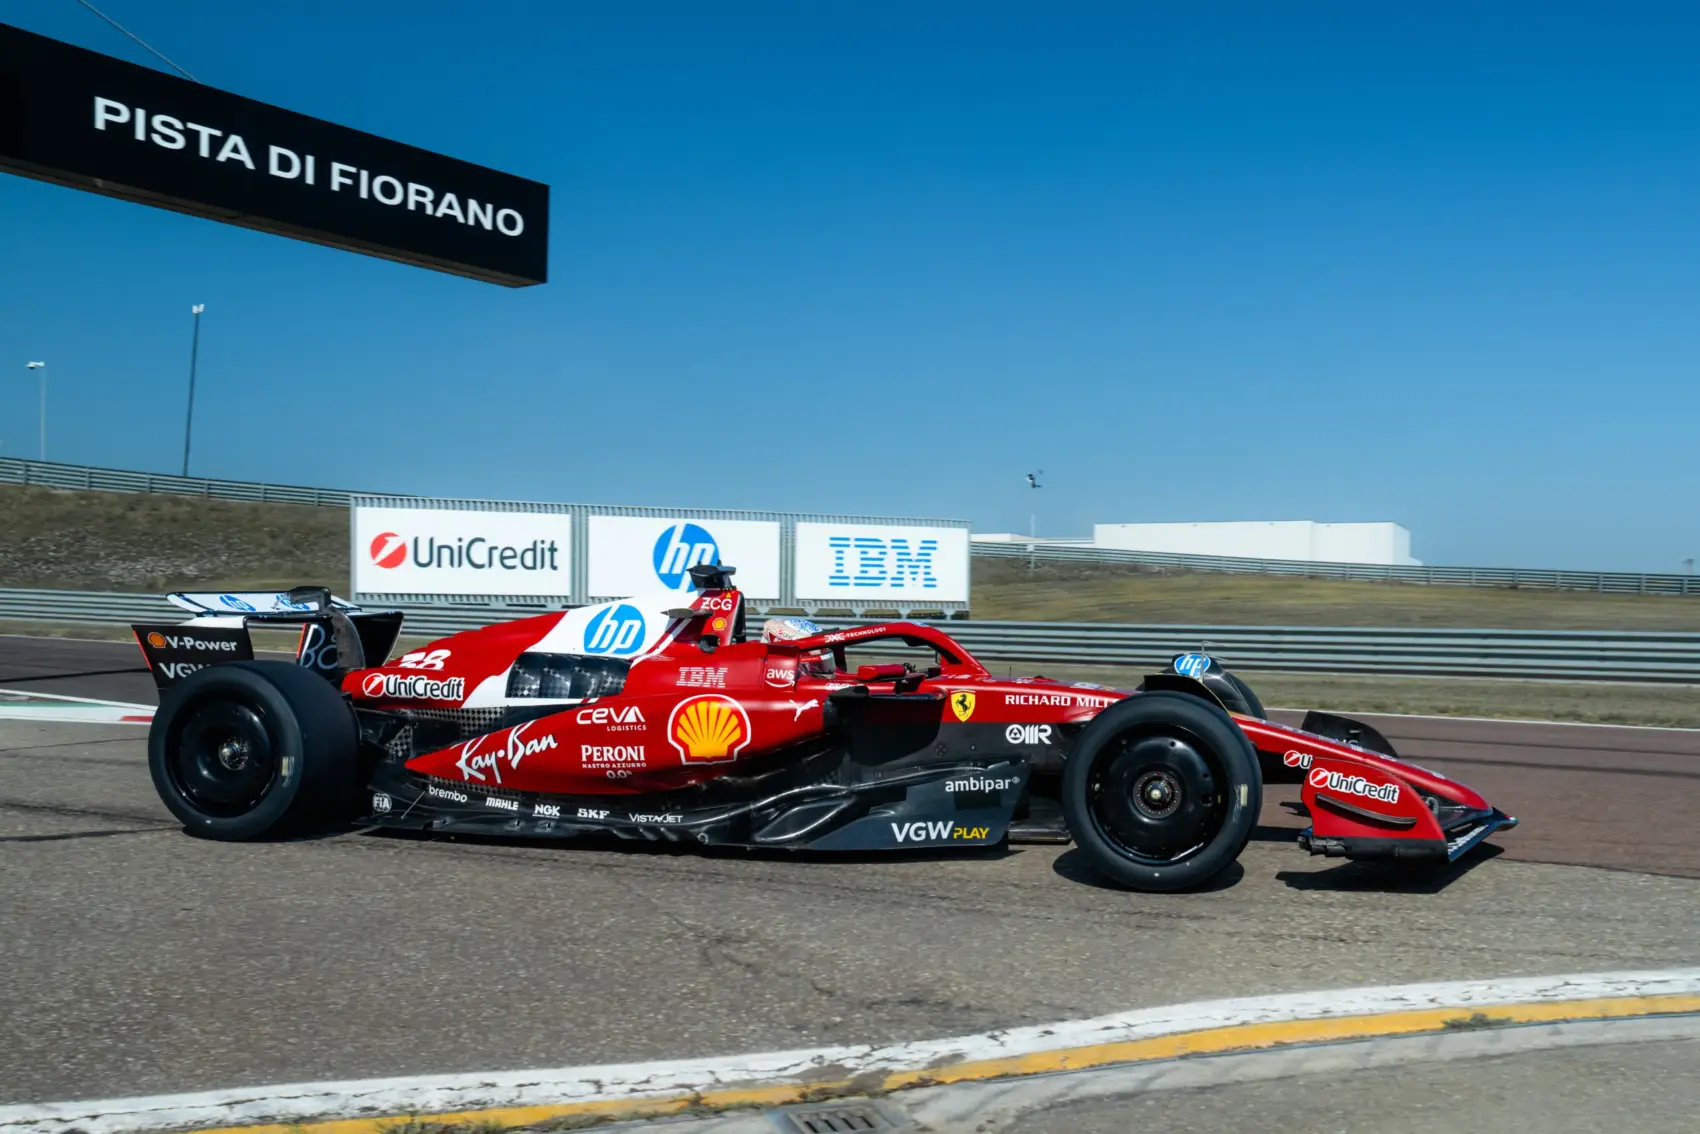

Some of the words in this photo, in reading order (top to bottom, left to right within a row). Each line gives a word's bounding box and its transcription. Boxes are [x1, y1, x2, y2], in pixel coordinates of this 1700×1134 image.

[94, 96, 255, 170] PISTA
[268, 144, 315, 186] DI
[331, 162, 524, 237] FIORANO
[413, 536, 558, 570] UniCredit
[659, 523, 716, 592] hp
[829, 537, 937, 588] IBM
[700, 597, 732, 610] ZCG
[587, 604, 642, 654] hp
[846, 627, 886, 638] TECHNOLOGY
[165, 636, 237, 651] V-Power
[766, 668, 795, 679] aws
[1179, 655, 1207, 677] hp
[676, 667, 728, 688] IBM
[385, 675, 464, 700] UniCredit
[1005, 694, 1071, 707] RICHARD
[606, 724, 647, 732] LOGISTICS
[581, 744, 645, 762] PERONI
[428, 784, 468, 803] brembo
[1328, 771, 1400, 803] UniCredit
[374, 796, 390, 809] FIA
[485, 796, 519, 811] MAHLE
[533, 804, 561, 817] NGK
[577, 808, 610, 819] SKF
[891, 820, 954, 843] VGW
[953, 827, 990, 840] PLAY
